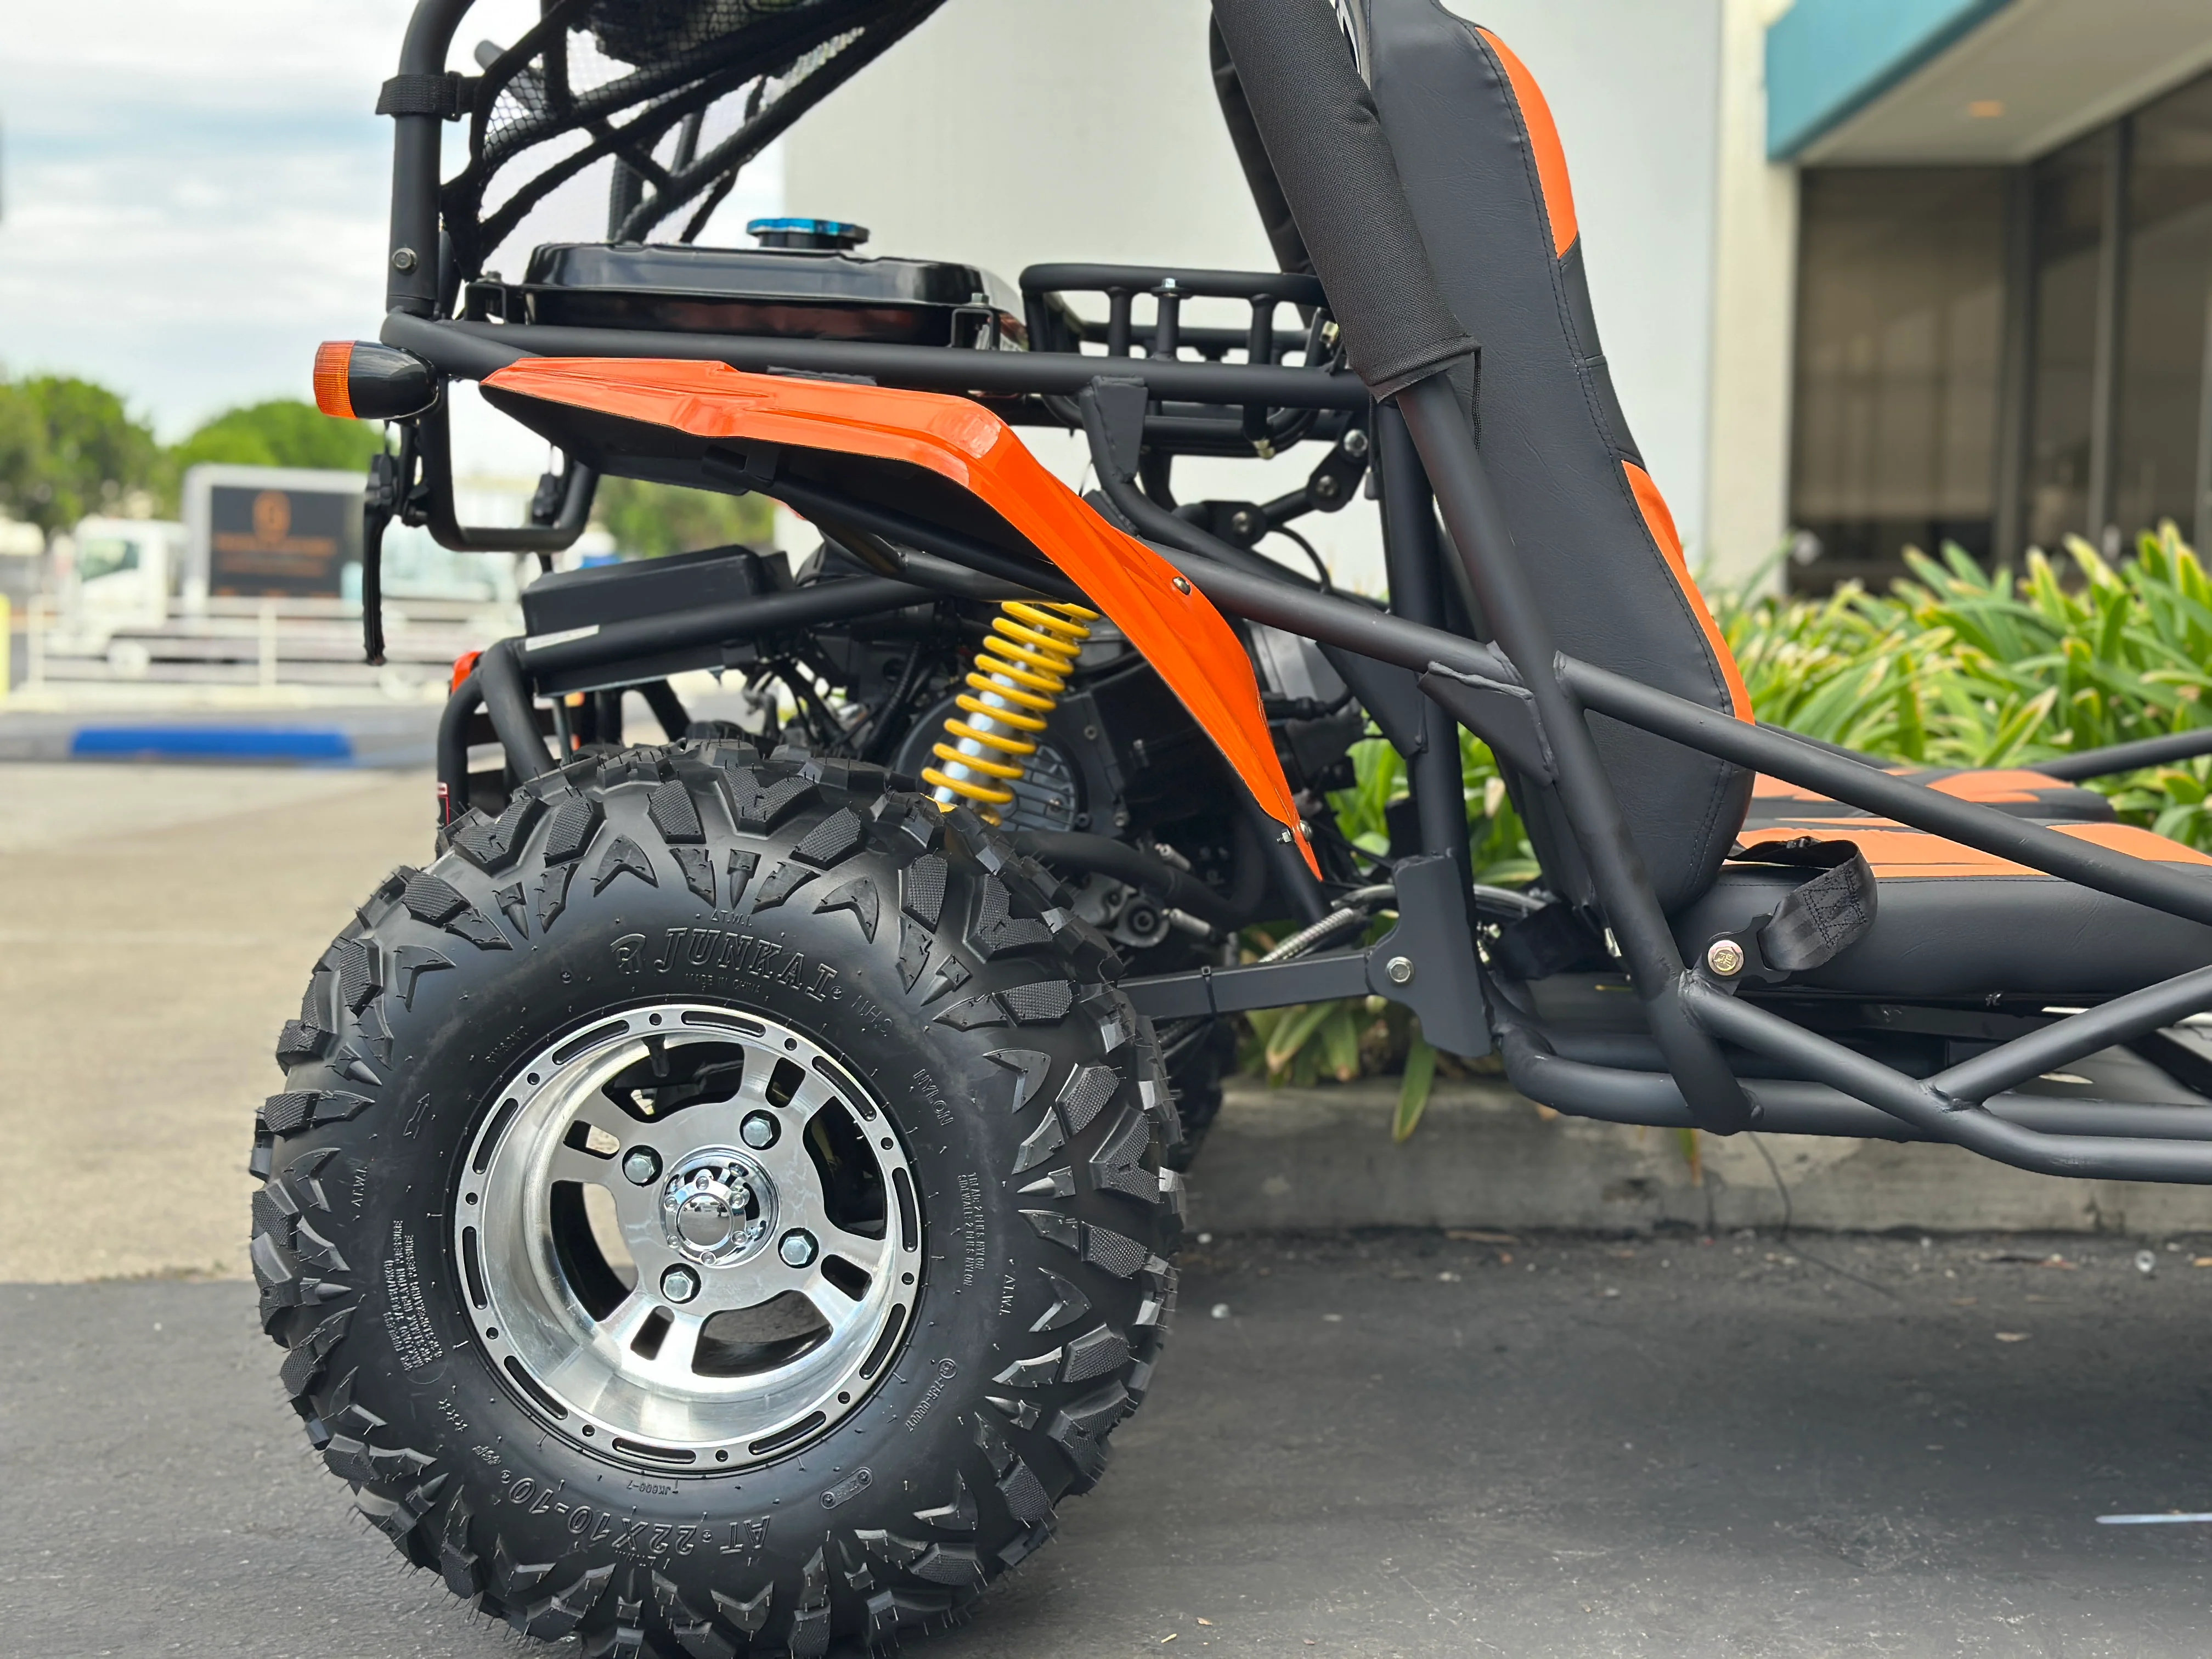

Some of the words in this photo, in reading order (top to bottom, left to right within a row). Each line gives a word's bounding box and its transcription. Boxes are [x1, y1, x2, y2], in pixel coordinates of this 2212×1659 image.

[654, 927, 838, 1002] JUNKAI
[685, 973, 713, 986] MADE
[718, 976, 729, 986] IN
[733, 979, 761, 994] CHINA
[913, 1069, 953, 1125] NYLON
[963, 1257, 974, 1286] NYLON
[975, 1241, 985, 1269] NYLON
[627, 1480, 672, 1496] JK600-7
[509, 1477, 697, 1556] 22X10-10
[720, 1516, 770, 1555] AT
